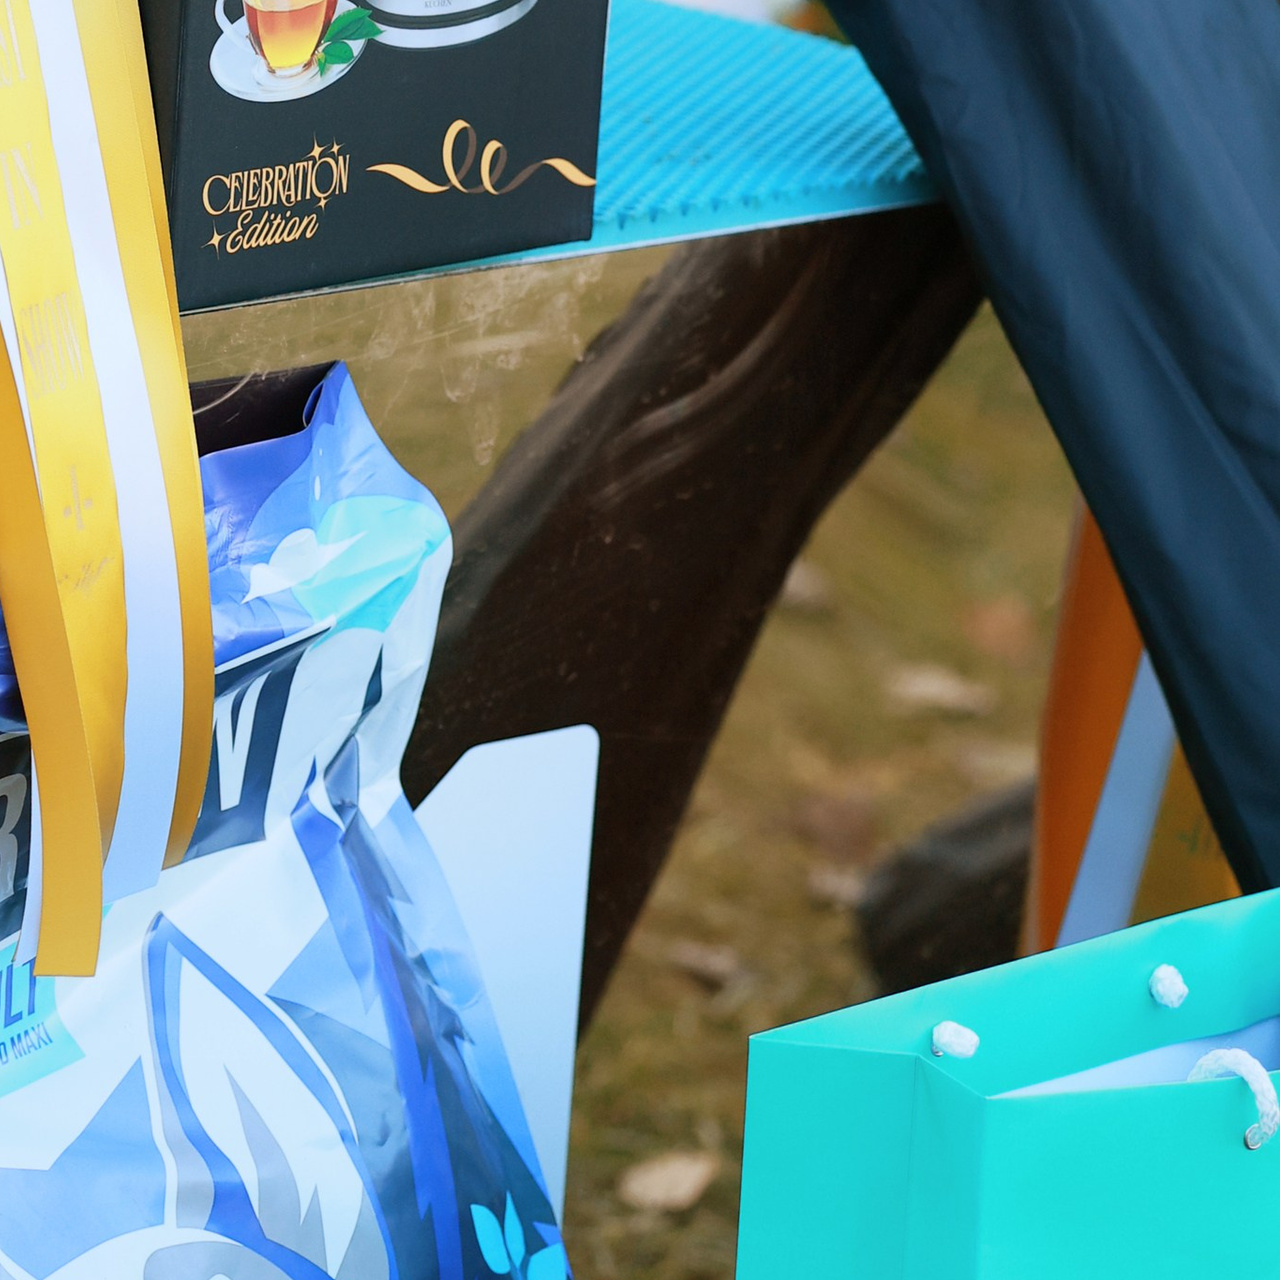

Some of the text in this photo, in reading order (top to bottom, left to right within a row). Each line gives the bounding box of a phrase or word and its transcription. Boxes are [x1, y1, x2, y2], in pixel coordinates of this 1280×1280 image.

[202, 154, 351, 216] CELEBRATION
[225, 210, 319, 254] Edition
[20, 290, 85, 400] SHOW
[10, 1021, 53, 1060] MAXI
